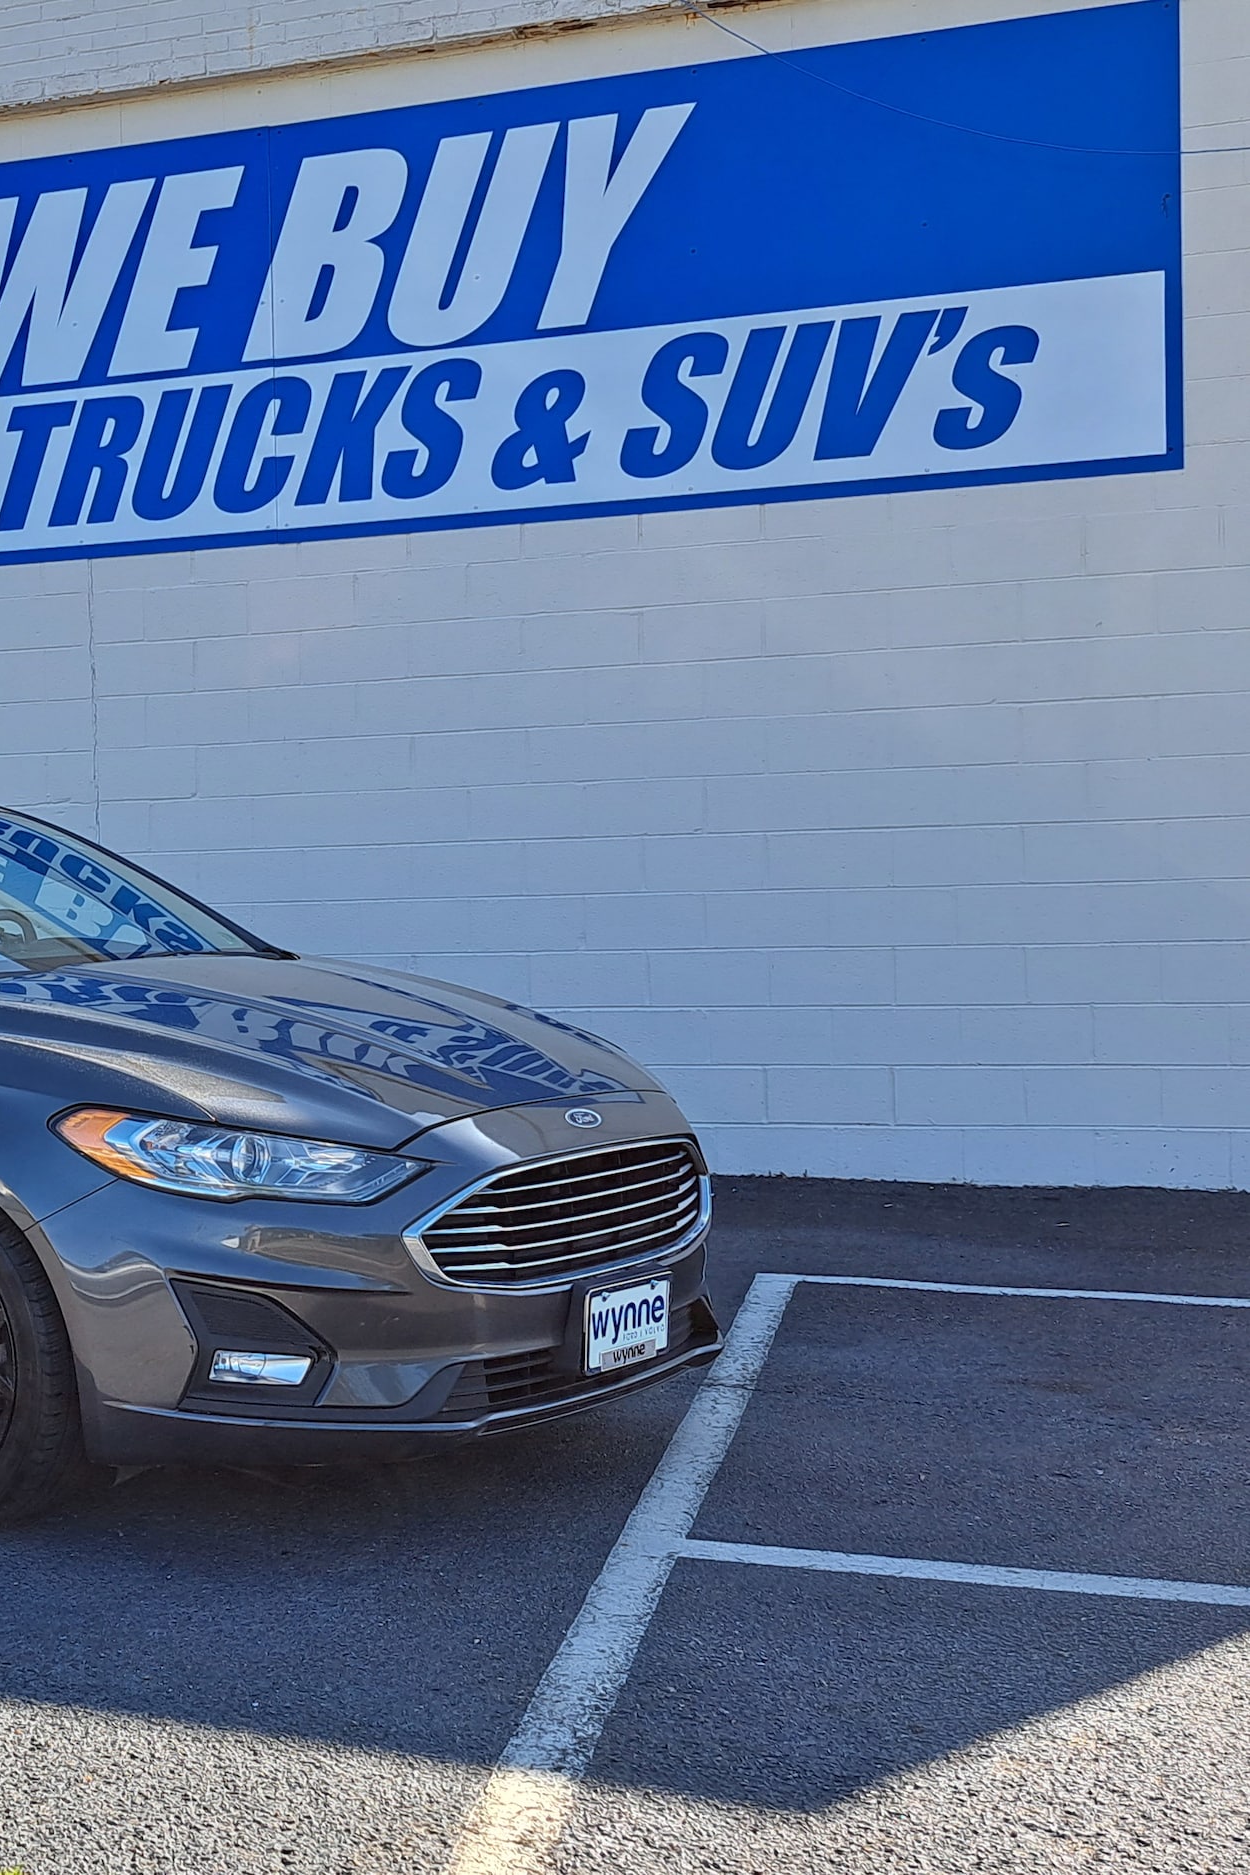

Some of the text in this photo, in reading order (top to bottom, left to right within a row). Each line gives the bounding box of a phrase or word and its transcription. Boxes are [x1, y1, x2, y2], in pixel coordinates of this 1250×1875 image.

[242, 103, 696, 362] BUY
[491, 369, 591, 490] &
[620, 306, 1040, 478] SUV's
[592, 1295, 665, 1344] wynne
[612, 1343, 646, 1364] wynne
